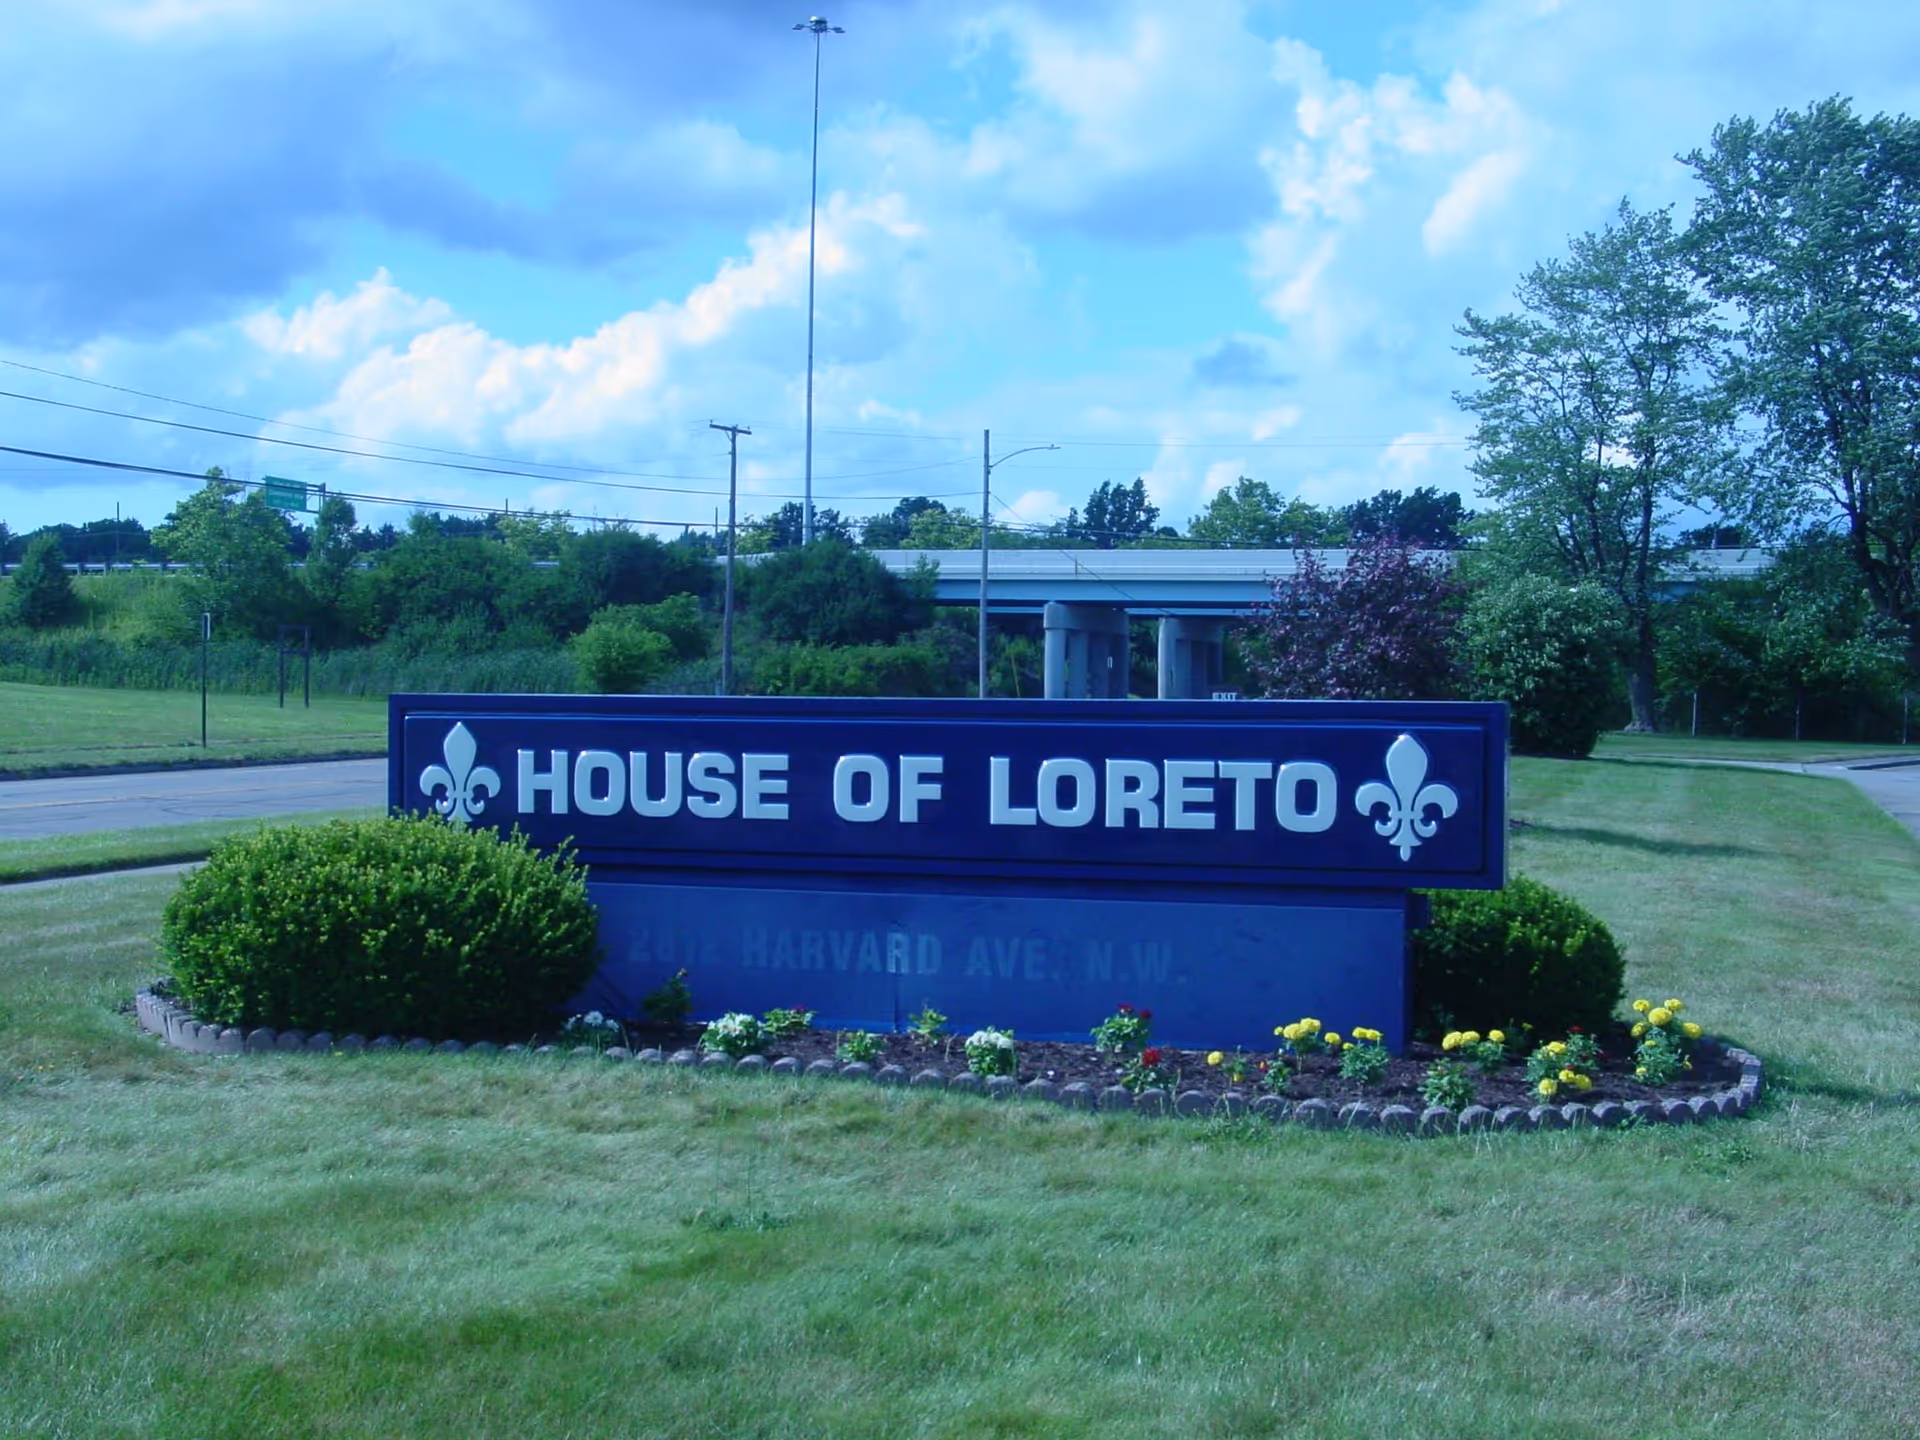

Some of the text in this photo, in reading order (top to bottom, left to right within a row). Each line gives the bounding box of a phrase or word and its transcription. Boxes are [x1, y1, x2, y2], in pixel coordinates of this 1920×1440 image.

[1212, 692, 1238, 701] EXIT
[517, 748, 1338, 833] HOUSE OF LORETO
[741, 927, 944, 976] HARVARD
